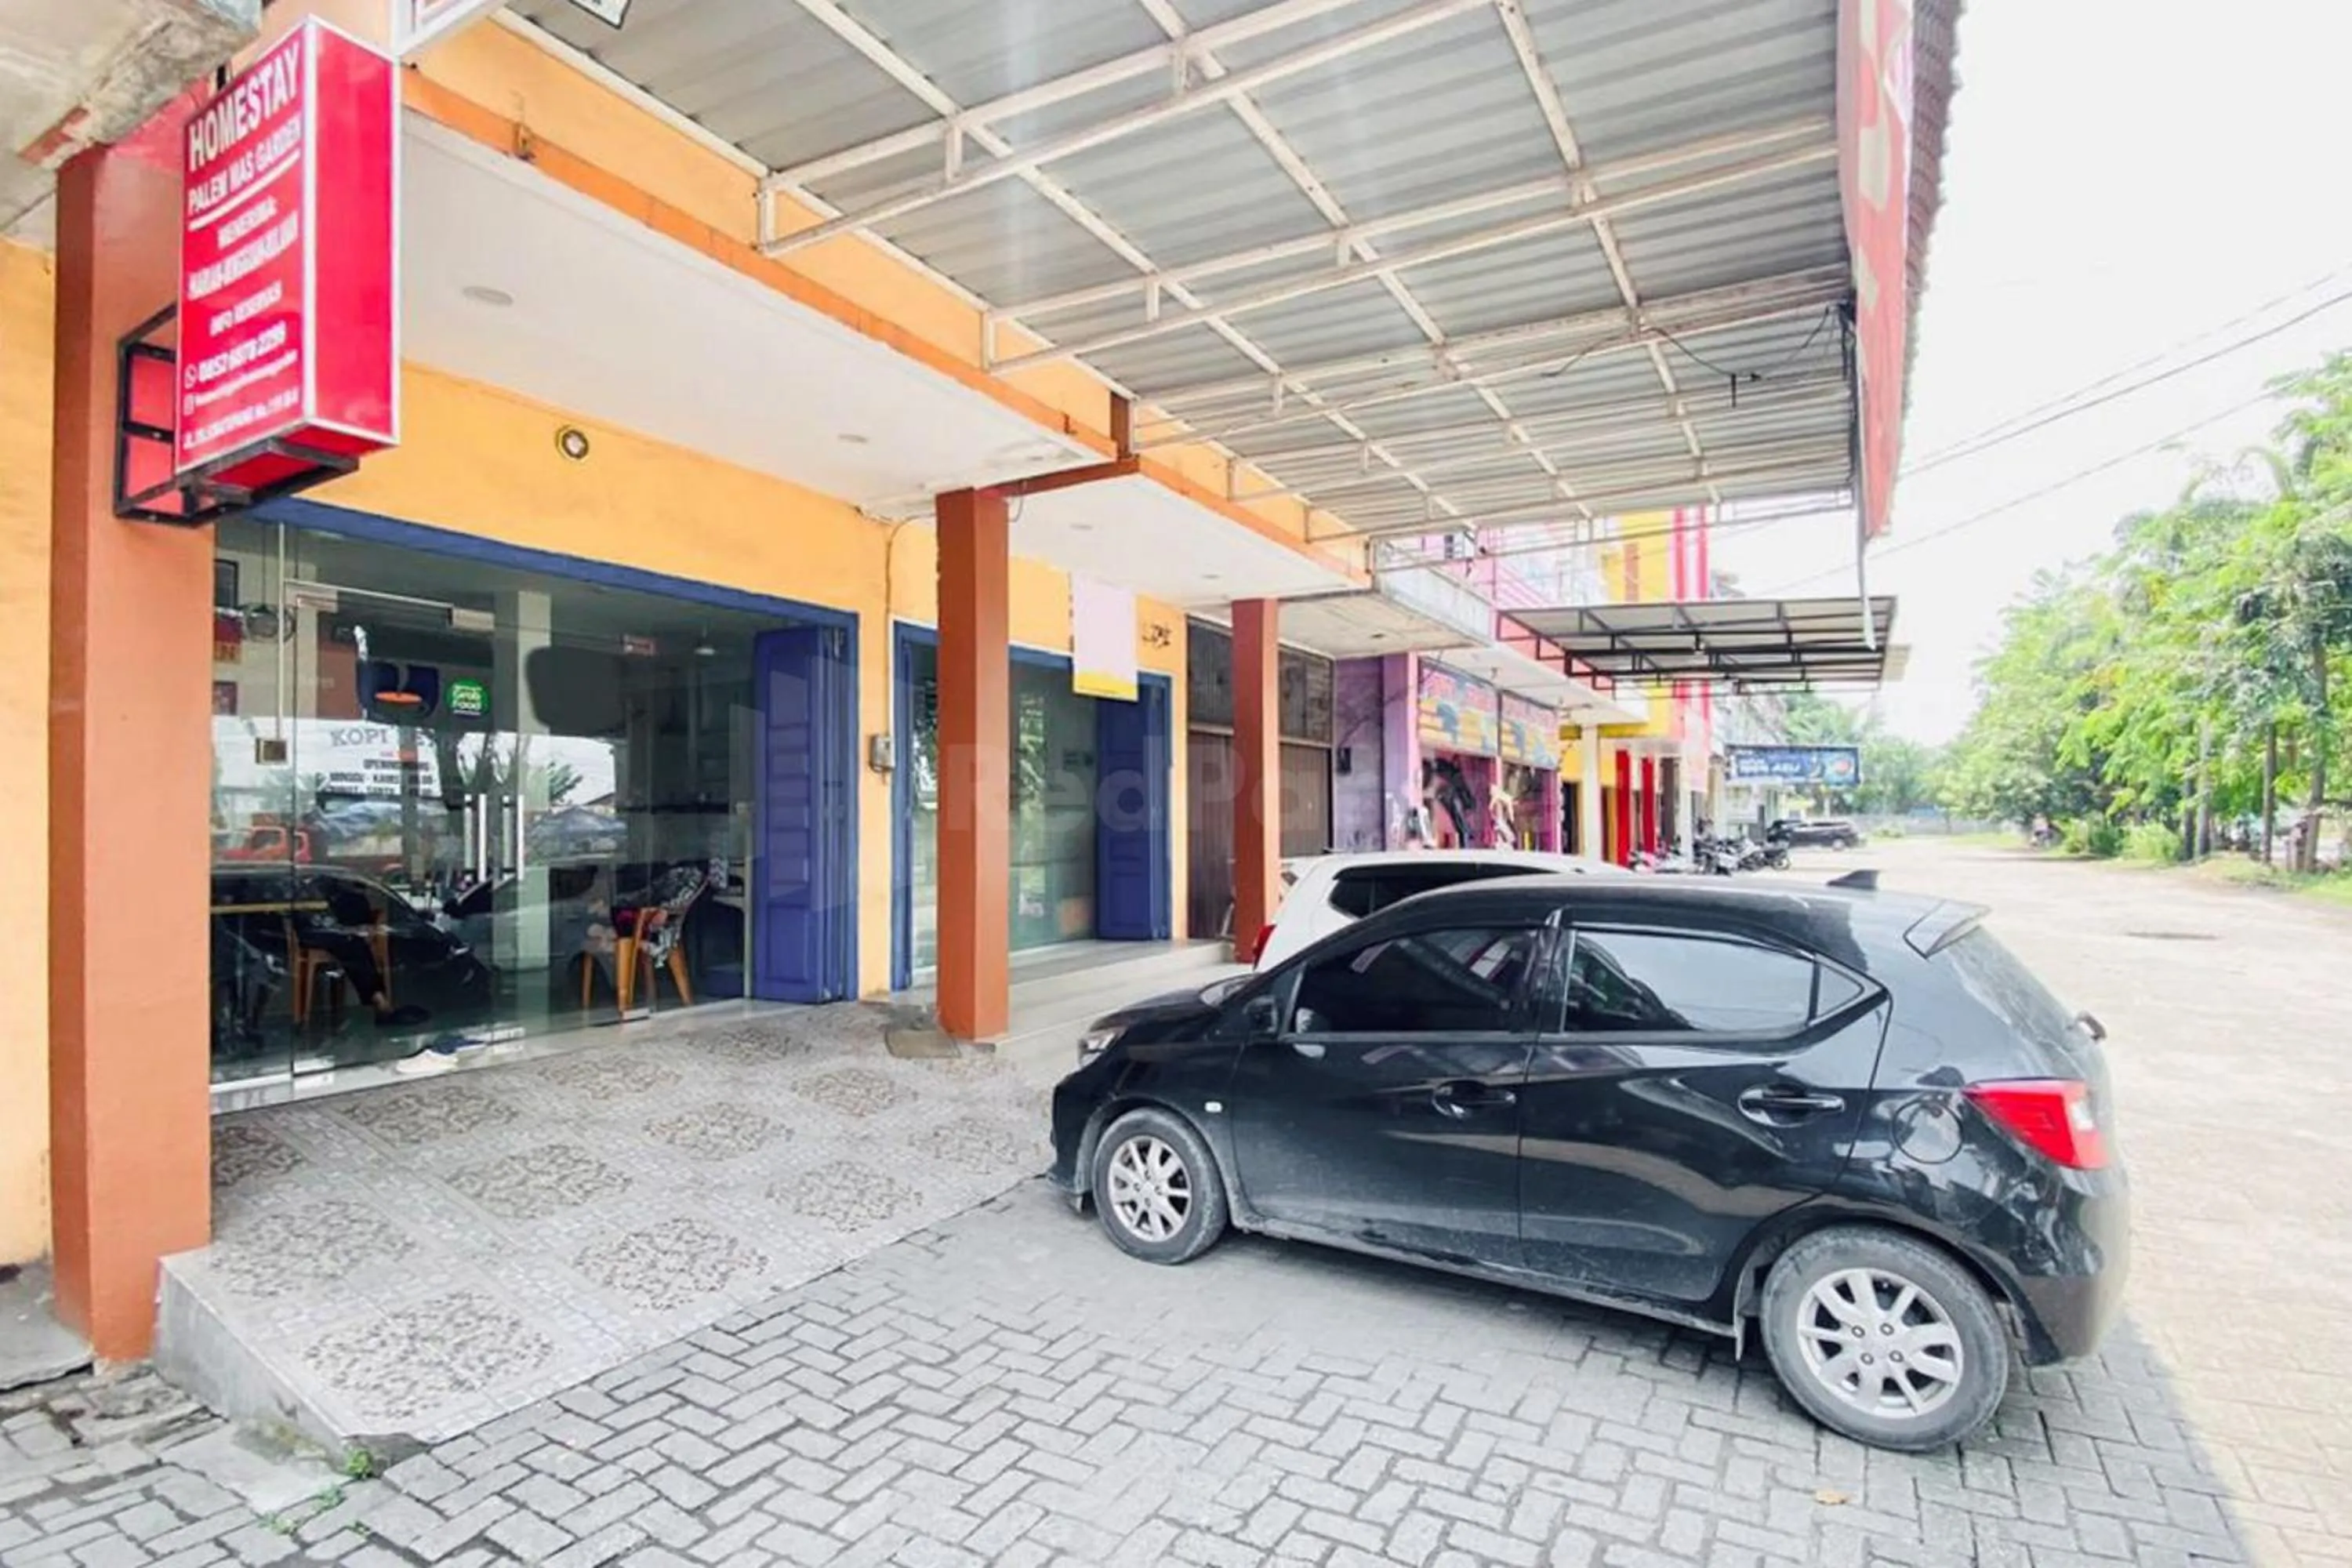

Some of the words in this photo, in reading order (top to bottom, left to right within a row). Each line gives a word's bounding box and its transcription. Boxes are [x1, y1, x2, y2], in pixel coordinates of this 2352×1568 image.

[189, 42, 299, 173] HOMESTAY
[188, 171, 227, 216] PALEM
[229, 151, 255, 193] MAS
[331, 728, 387, 746] KOPI
